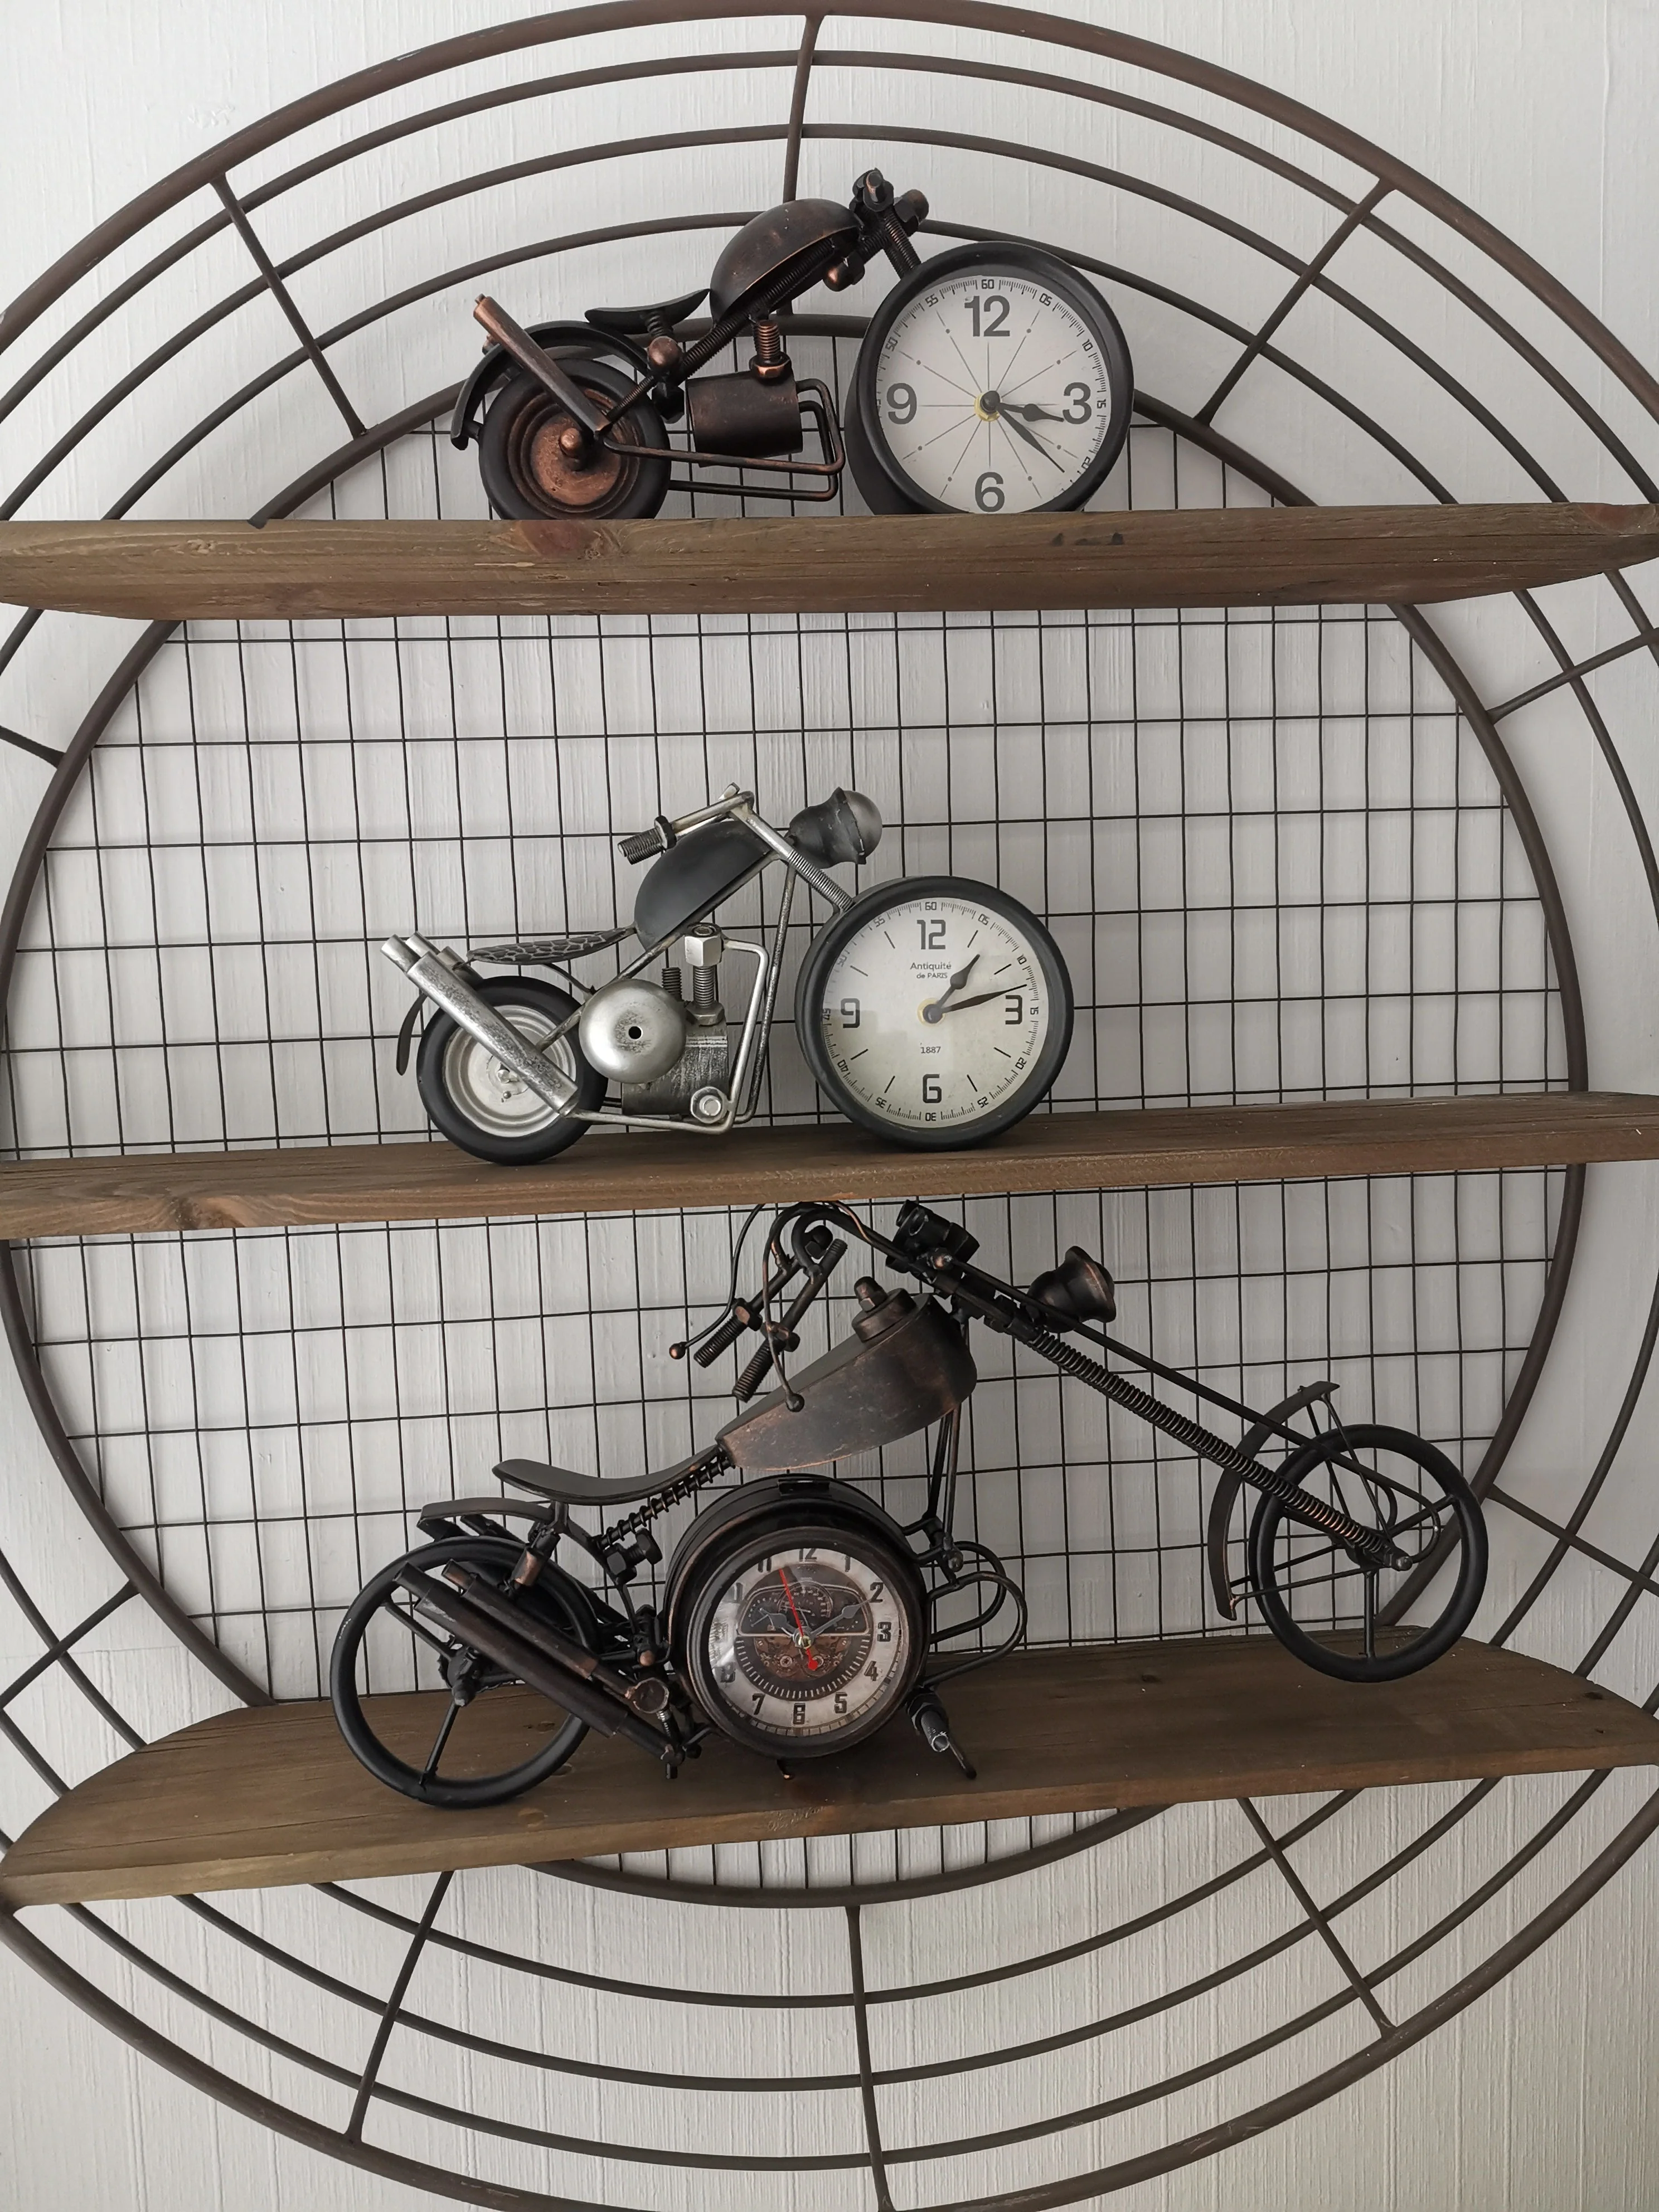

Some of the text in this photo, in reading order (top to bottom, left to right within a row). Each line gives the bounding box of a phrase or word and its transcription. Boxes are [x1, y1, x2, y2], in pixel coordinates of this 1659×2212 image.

[981, 279, 995, 289] 60
[925, 294, 939, 307] 55
[1039, 293, 1052, 307] 05
[964, 295, 1010, 337] 12
[885, 336, 898, 352] 50
[1083, 339, 1093, 351] 10
[886, 382, 917, 425] 9
[1063, 382, 1092, 425] 3
[1097, 399, 1107, 409] 15
[974, 472, 1005, 512] 6
[925, 901, 937, 911] 60
[978, 914, 989, 925] 05
[916, 919, 946, 950] 12
[910, 962, 952, 971] Antiquité
[1017, 954, 1027, 965] 10
[841, 998, 860, 1028] 9
[1005, 995, 1023, 1025] 3
[1030, 1007, 1039, 1015] 15
[837, 1060, 848, 1073] 40
[1015, 1058, 1027, 1070] 20
[923, 1074, 942, 1103] 6
[876, 1098, 887, 1108] 35
[977, 1098, 988, 1108] 25
[925, 1112, 937, 1121] 30
[870, 1582, 884, 1603] 2
[877, 1622, 891, 1642] 3
[864, 1661, 878, 1681] 4
[752, 1693, 765, 1715] 7
[835, 1692, 847, 1714] 5
[793, 1703, 806, 1725] 6
